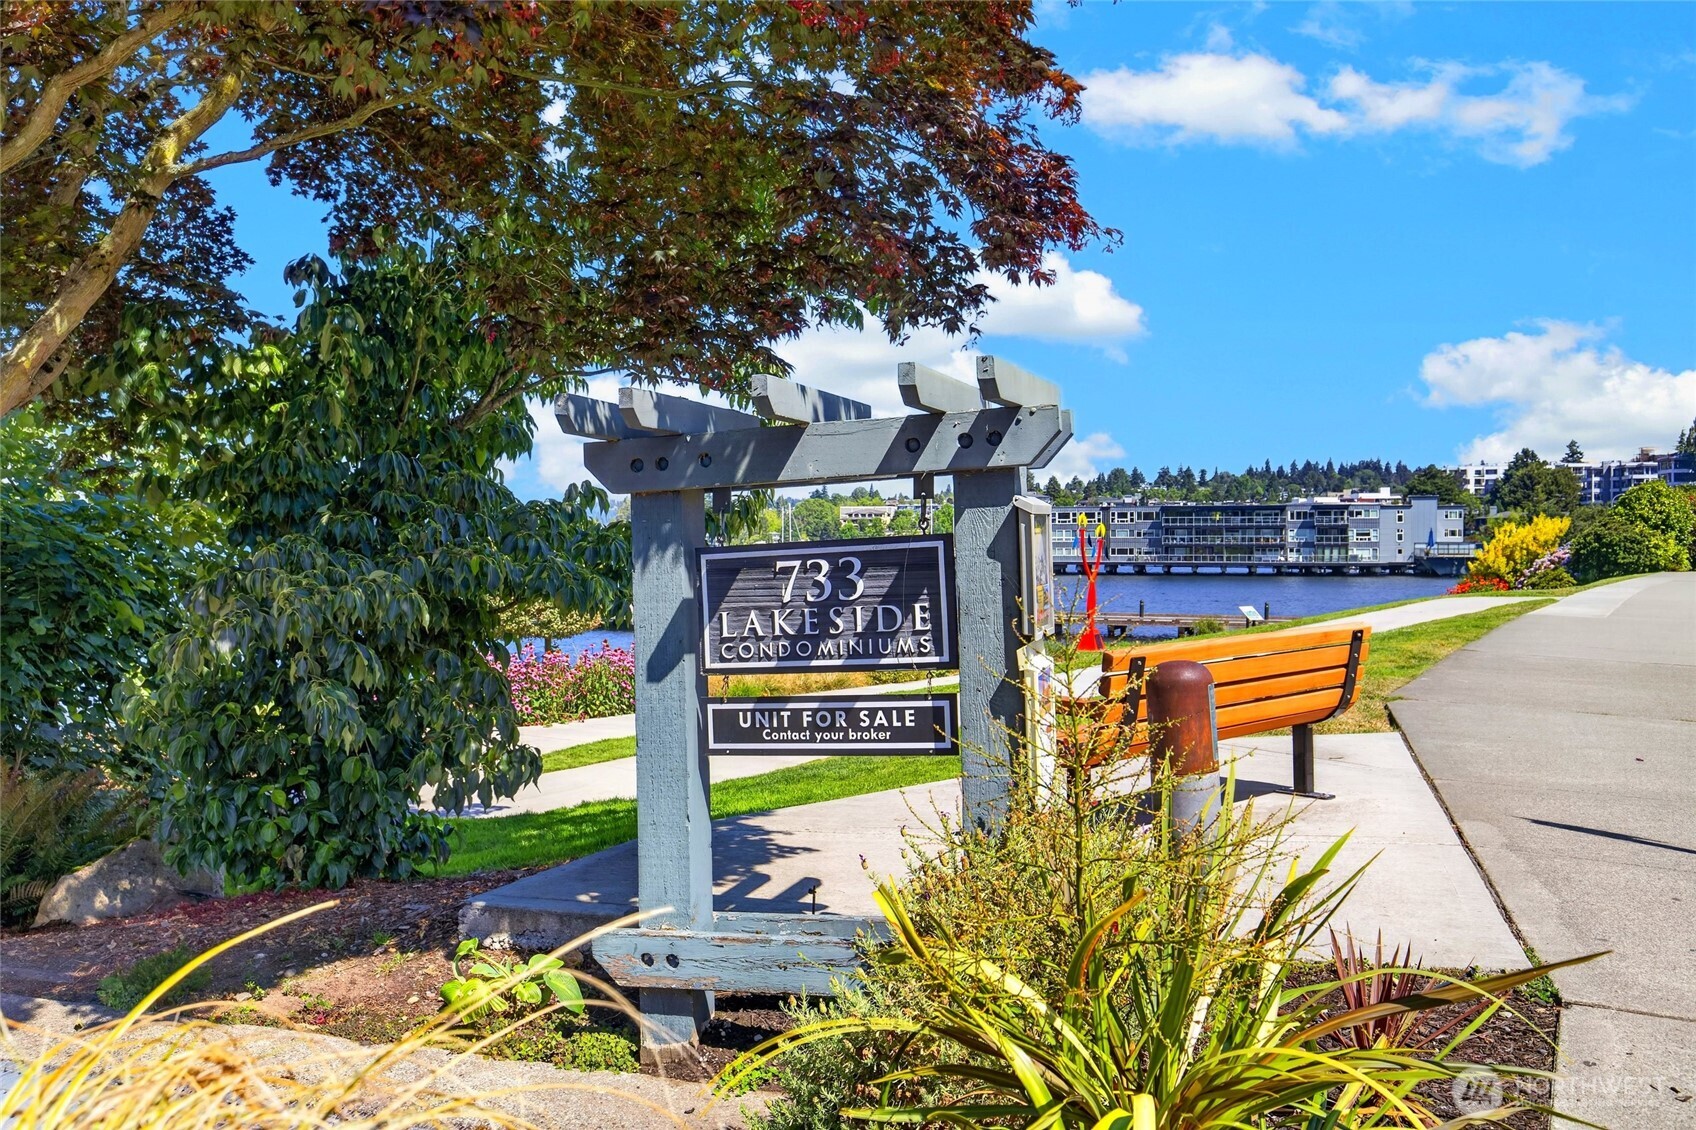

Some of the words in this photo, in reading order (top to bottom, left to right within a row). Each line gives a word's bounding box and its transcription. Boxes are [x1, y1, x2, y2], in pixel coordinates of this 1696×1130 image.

[775, 556, 865, 603] 733
[719, 603, 932, 638] LAKESIDE
[721, 637, 931, 659] CONDOMINIUMS
[738, 711, 791, 728] UNIT
[803, 711, 848, 727] FOR
[859, 709, 916, 727] SALE
[762, 729, 811, 740] Contact
[815, 732, 845, 743] your
[849, 729, 891, 741] broker
